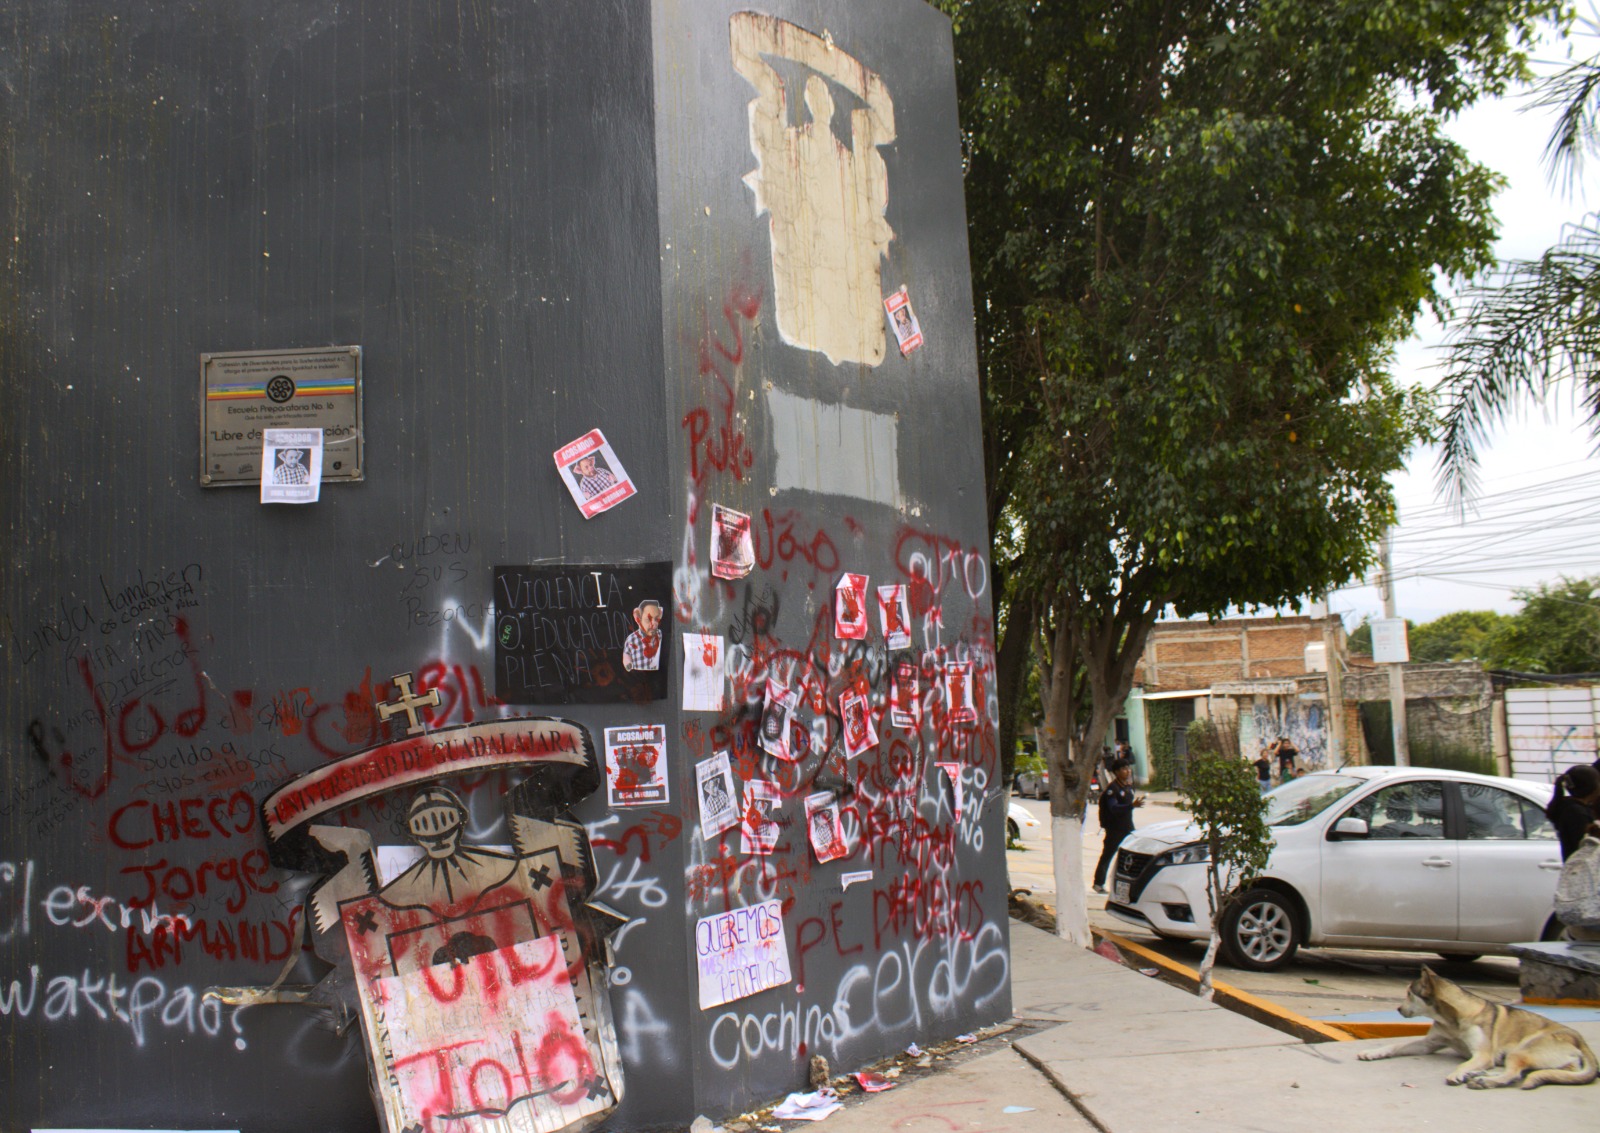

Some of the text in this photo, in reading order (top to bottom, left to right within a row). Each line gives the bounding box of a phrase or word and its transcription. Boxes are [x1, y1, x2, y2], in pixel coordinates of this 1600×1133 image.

[227, 402, 334, 415] Escuela Preparatoria No. 16
[247, 429, 262, 440] de
[561, 437, 595, 461] ACOSADOR
[390, 532, 471, 561] CUIDEN
[414, 562, 469, 589] SUS
[121, 582, 194, 624] CORRUPTA
[6, 597, 96, 665] Linda
[95, 641, 201, 706] DIRECTOR
[505, 650, 593, 688] PLENA
[138, 744, 213, 772] Sueldo
[273, 754, 399, 826] UNIVERSIDAD
[401, 745, 424, 772] DE
[431, 730, 580, 764] GUADALAJARA
[120, 849, 279, 914] Jorge
[696, 904, 781, 957] QUEREMOS
